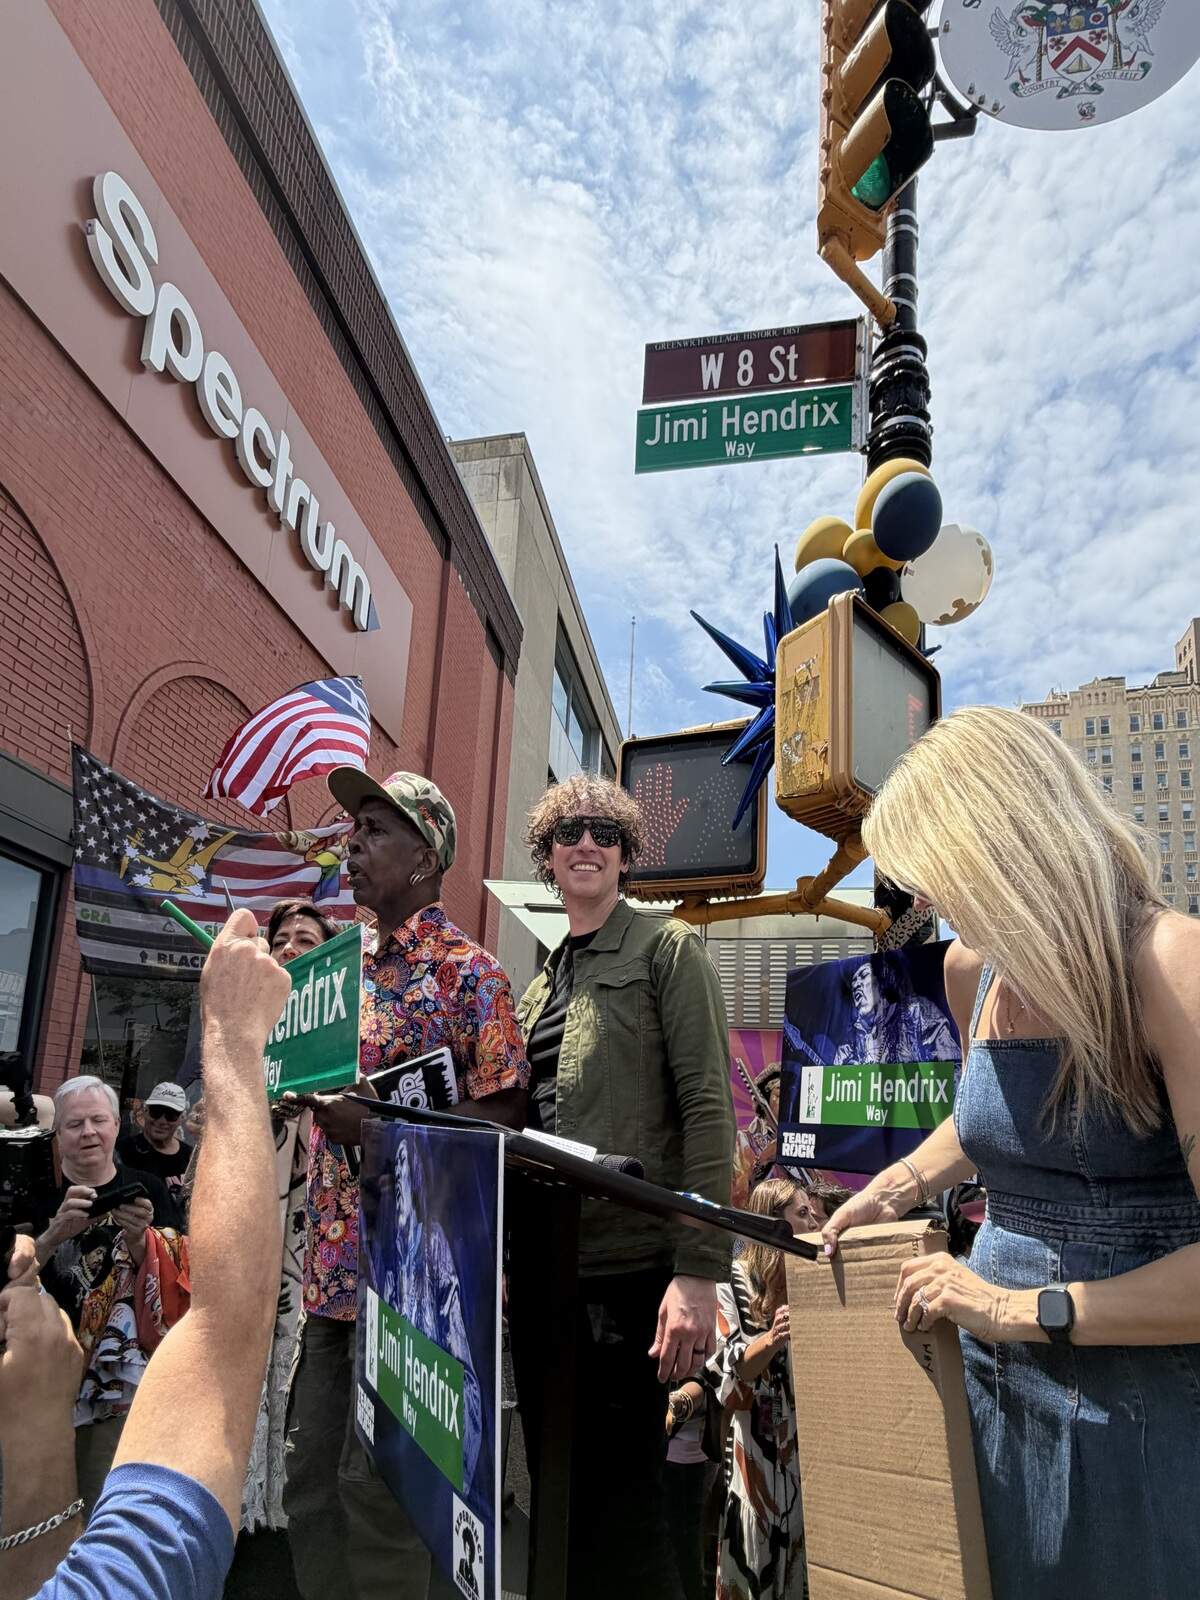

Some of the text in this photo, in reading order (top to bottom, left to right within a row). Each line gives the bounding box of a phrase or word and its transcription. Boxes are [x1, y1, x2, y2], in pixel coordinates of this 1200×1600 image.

[654, 326, 801, 351] GREENWICH VILLAGE HISTORIC DIST
[701, 344, 799, 391] W 8 St
[86, 171, 372, 632] Spectrum
[644, 396, 840, 446] Jimi Hendrix
[725, 440, 755, 458] Way
[268, 957, 348, 1046] endrix
[825, 1069, 949, 1104] Jimi Hendrix
[866, 1105, 888, 1125] Way
[782, 1132, 816, 1145] TEACH
[782, 1144, 816, 1159] ROCK
[379, 1314, 460, 1441] Jimi Hendrix
[402, 1391, 418, 1437] Way
